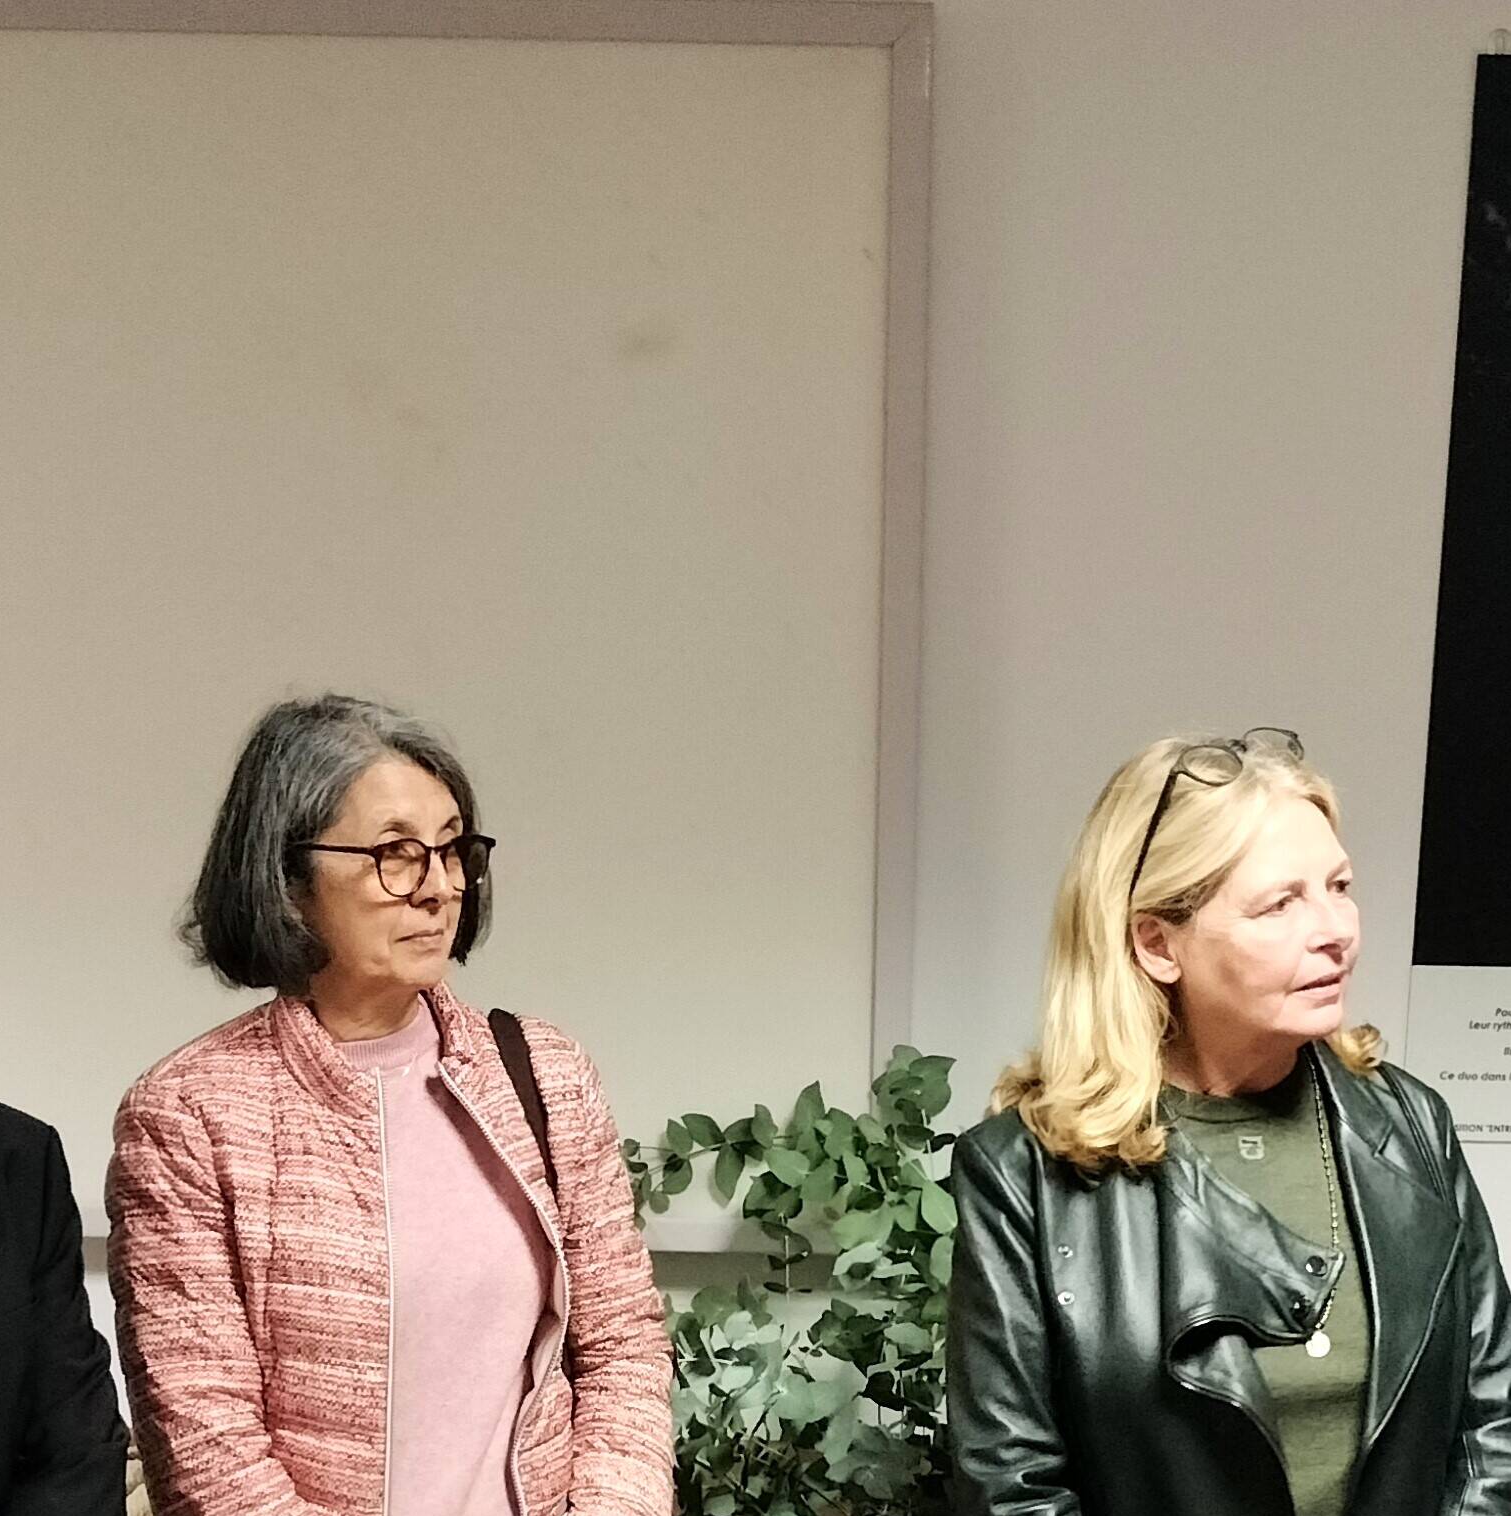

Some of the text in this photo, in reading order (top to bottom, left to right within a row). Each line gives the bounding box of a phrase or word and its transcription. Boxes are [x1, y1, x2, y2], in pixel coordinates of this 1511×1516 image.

[1469, 1020, 1491, 1030] Leur
[1439, 1071, 1455, 1081] Ce
[1457, 1071, 1478, 1081] duo
[1480, 1072, 1506, 1081] dans
